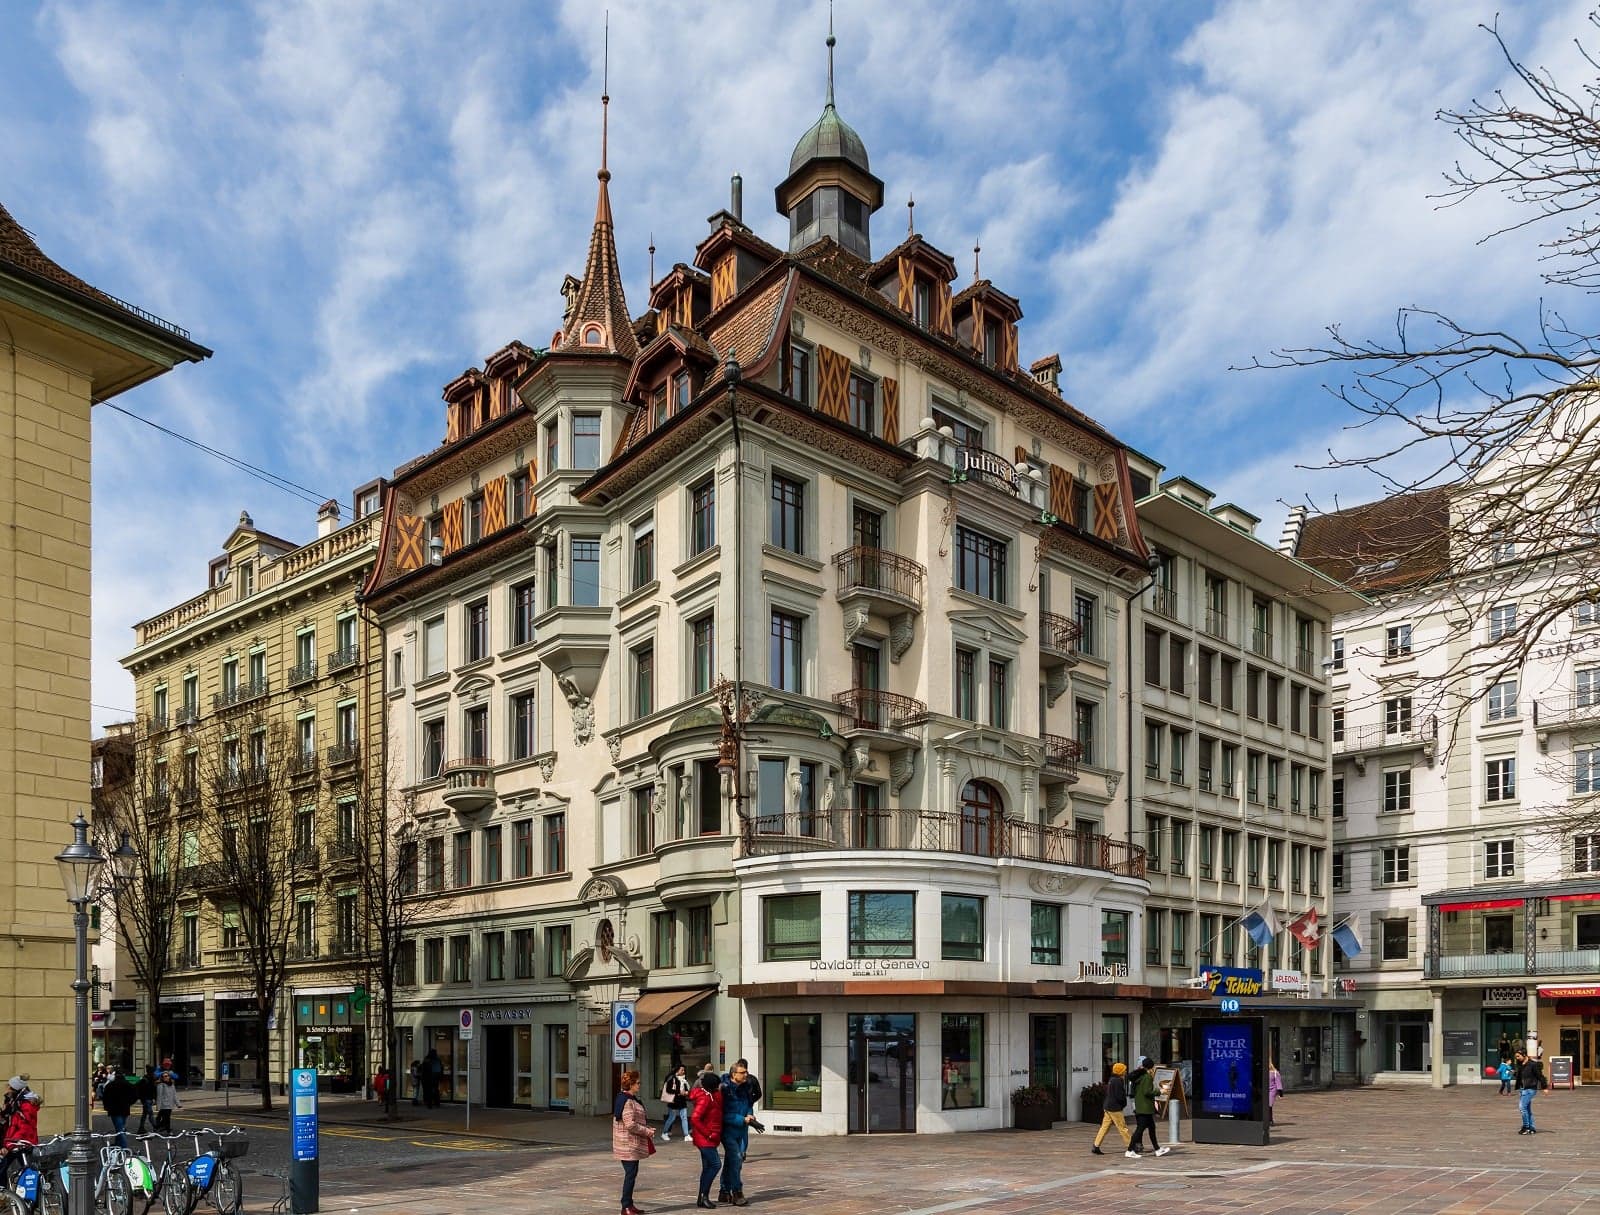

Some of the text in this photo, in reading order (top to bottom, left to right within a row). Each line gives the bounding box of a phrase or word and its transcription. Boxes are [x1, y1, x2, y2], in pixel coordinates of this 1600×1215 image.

[963, 451, 1007, 481] Julius
[810, 959, 930, 970] Davidoff of Geneva
[1226, 976, 1261, 995] Tchibo
[1275, 975, 1299, 984] APLEONA
[480, 1008, 532, 1020] EMBASSY
[1208, 1038, 1246, 1049] PETER
[1208, 1049, 1243, 1061] HASE
